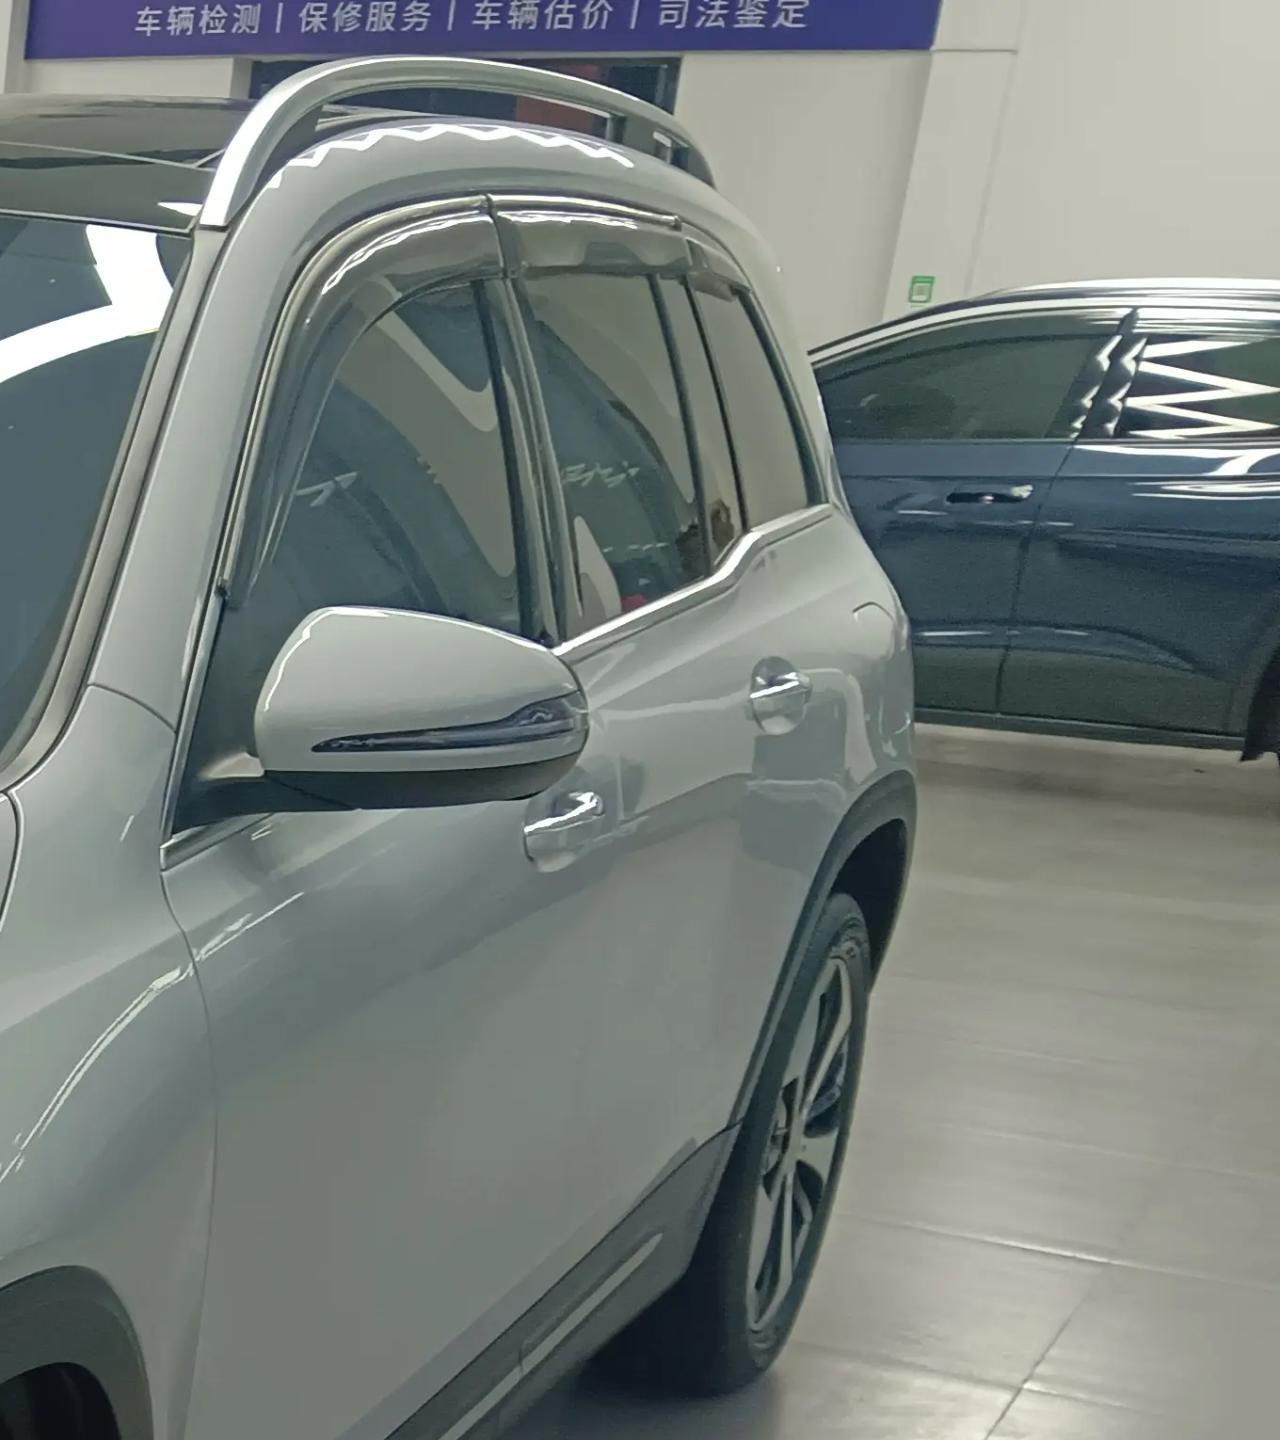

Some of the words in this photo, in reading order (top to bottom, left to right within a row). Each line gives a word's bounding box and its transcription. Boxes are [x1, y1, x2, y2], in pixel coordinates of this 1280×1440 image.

[133, 3, 262, 37] 车辆检测
[298, 1, 433, 33] 保修服务
[471, 0, 614, 31] 车辆估价
[658, 0, 811, 30] 司法鉴定
